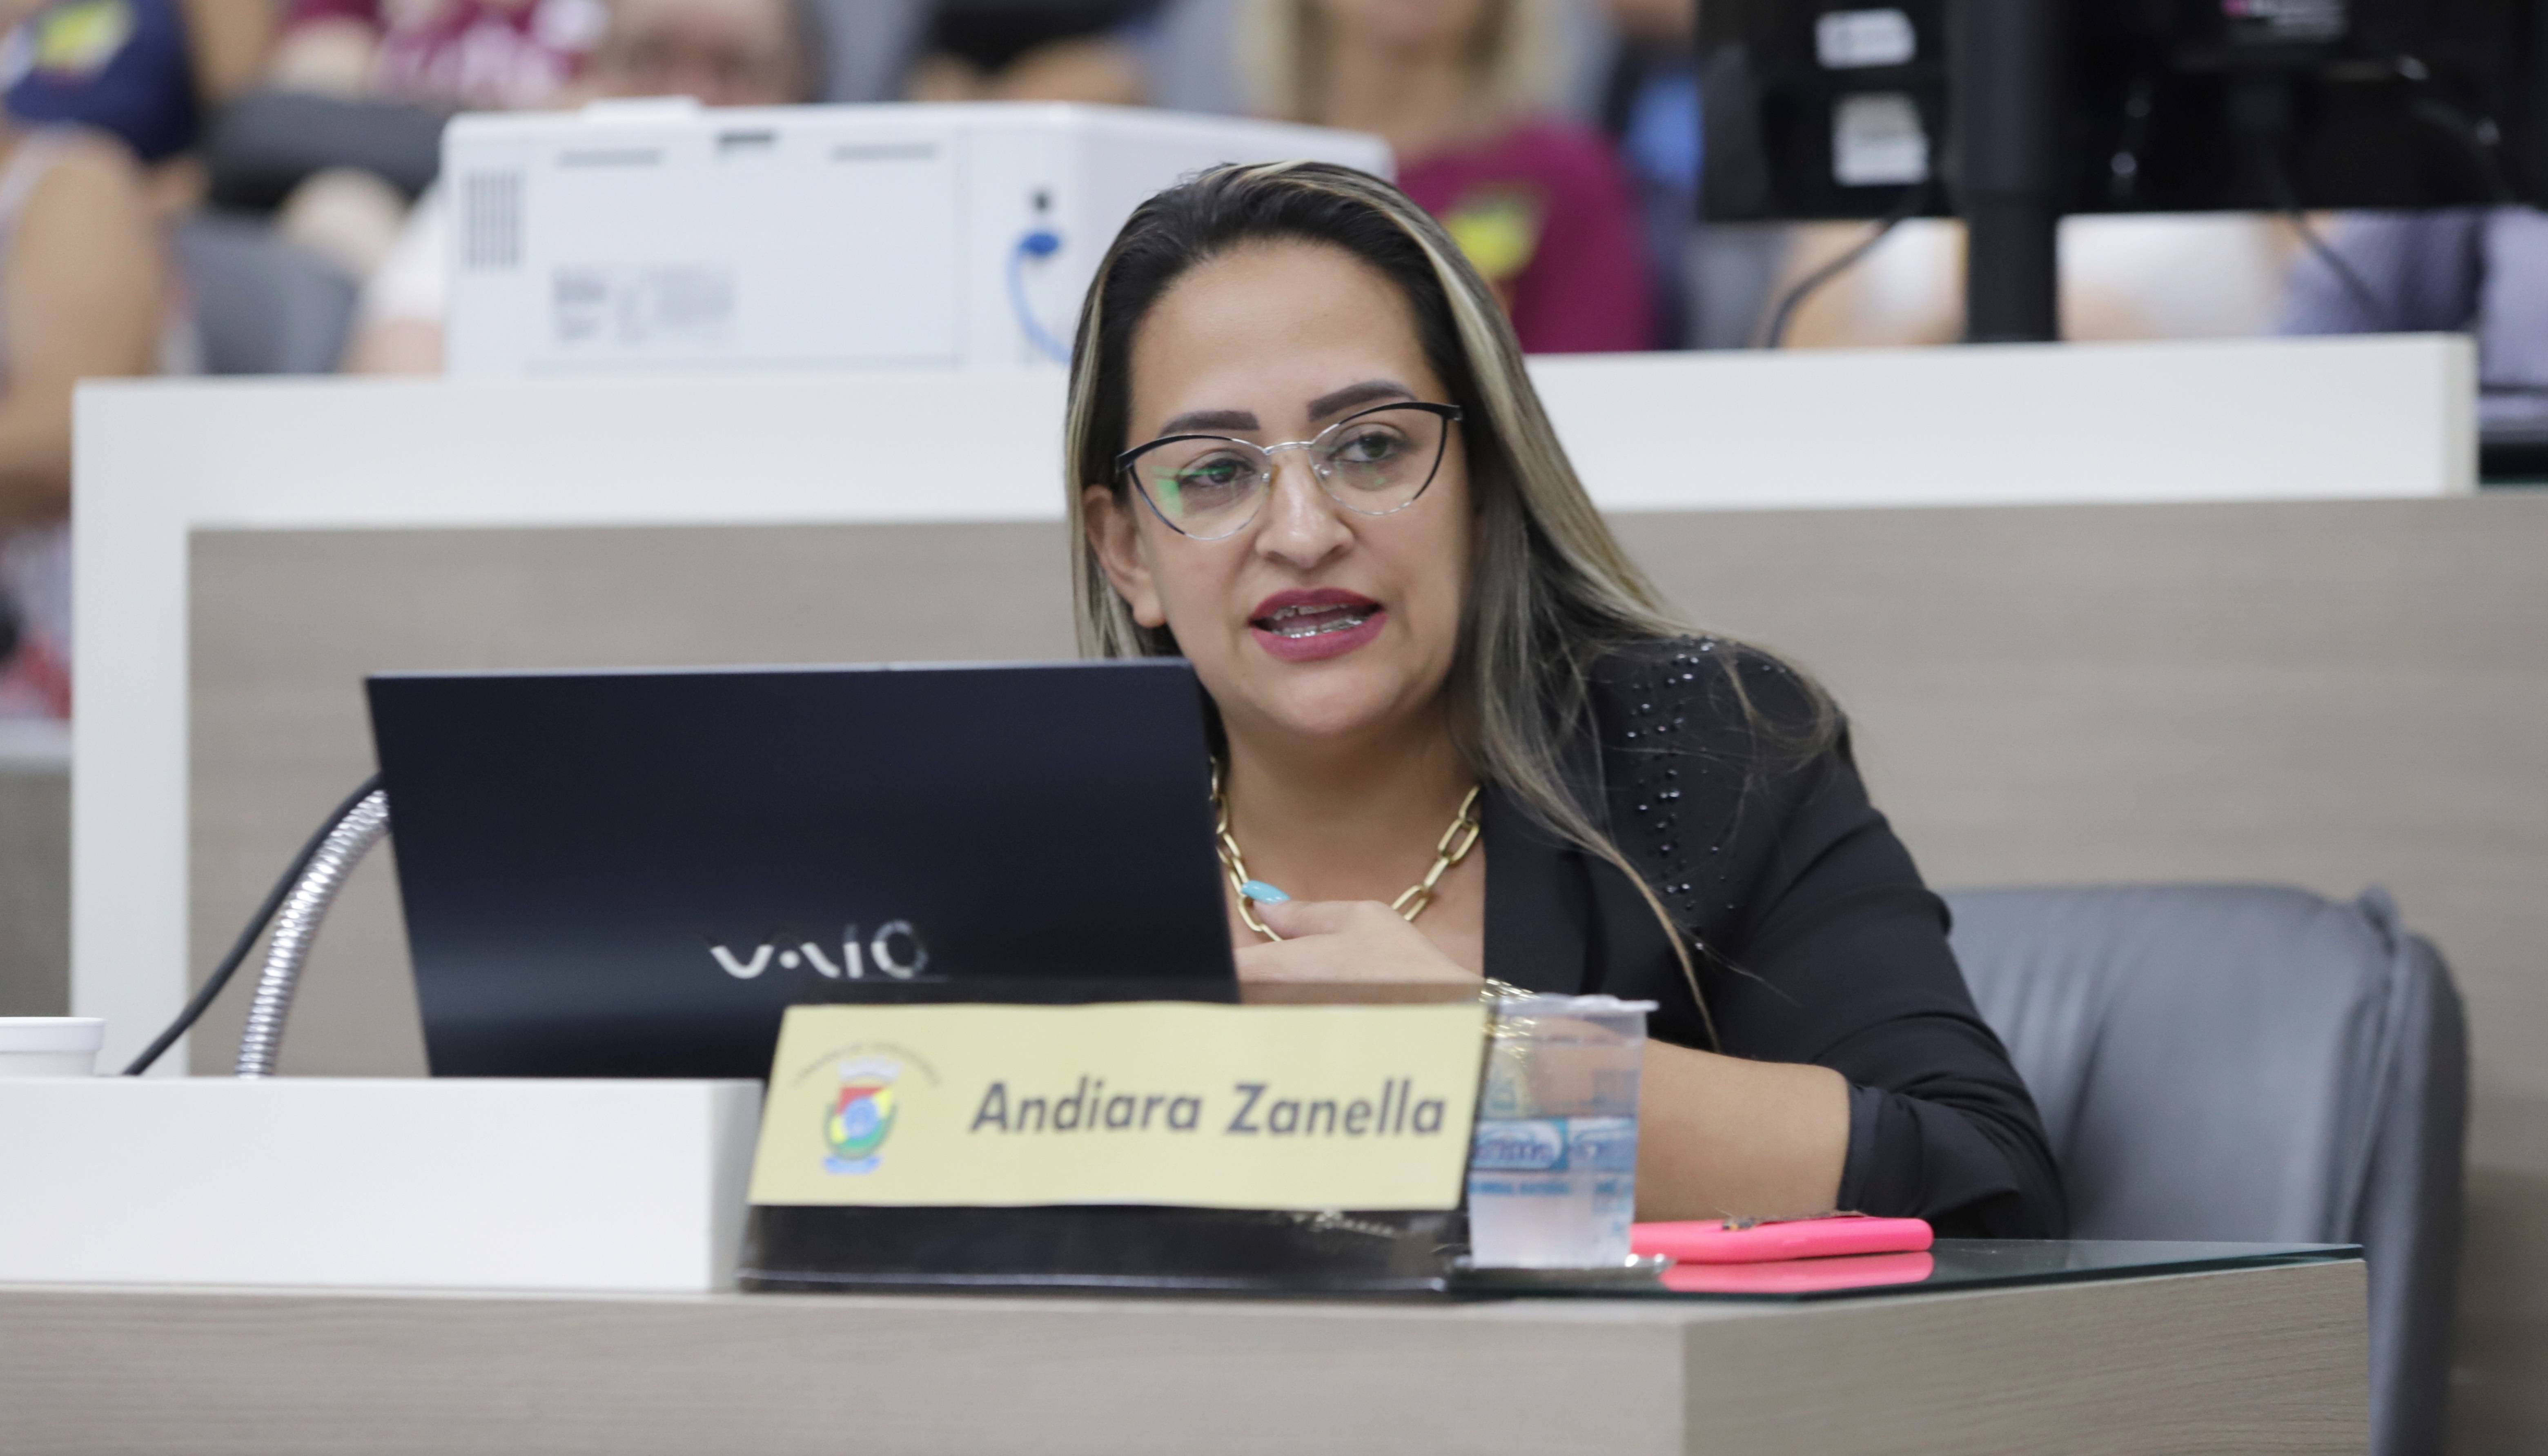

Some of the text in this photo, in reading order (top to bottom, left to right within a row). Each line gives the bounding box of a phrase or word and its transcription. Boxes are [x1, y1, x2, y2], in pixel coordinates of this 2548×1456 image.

[710, 919, 929, 979] VAIO
[969, 1075, 1446, 1137] Andiara Zanella
